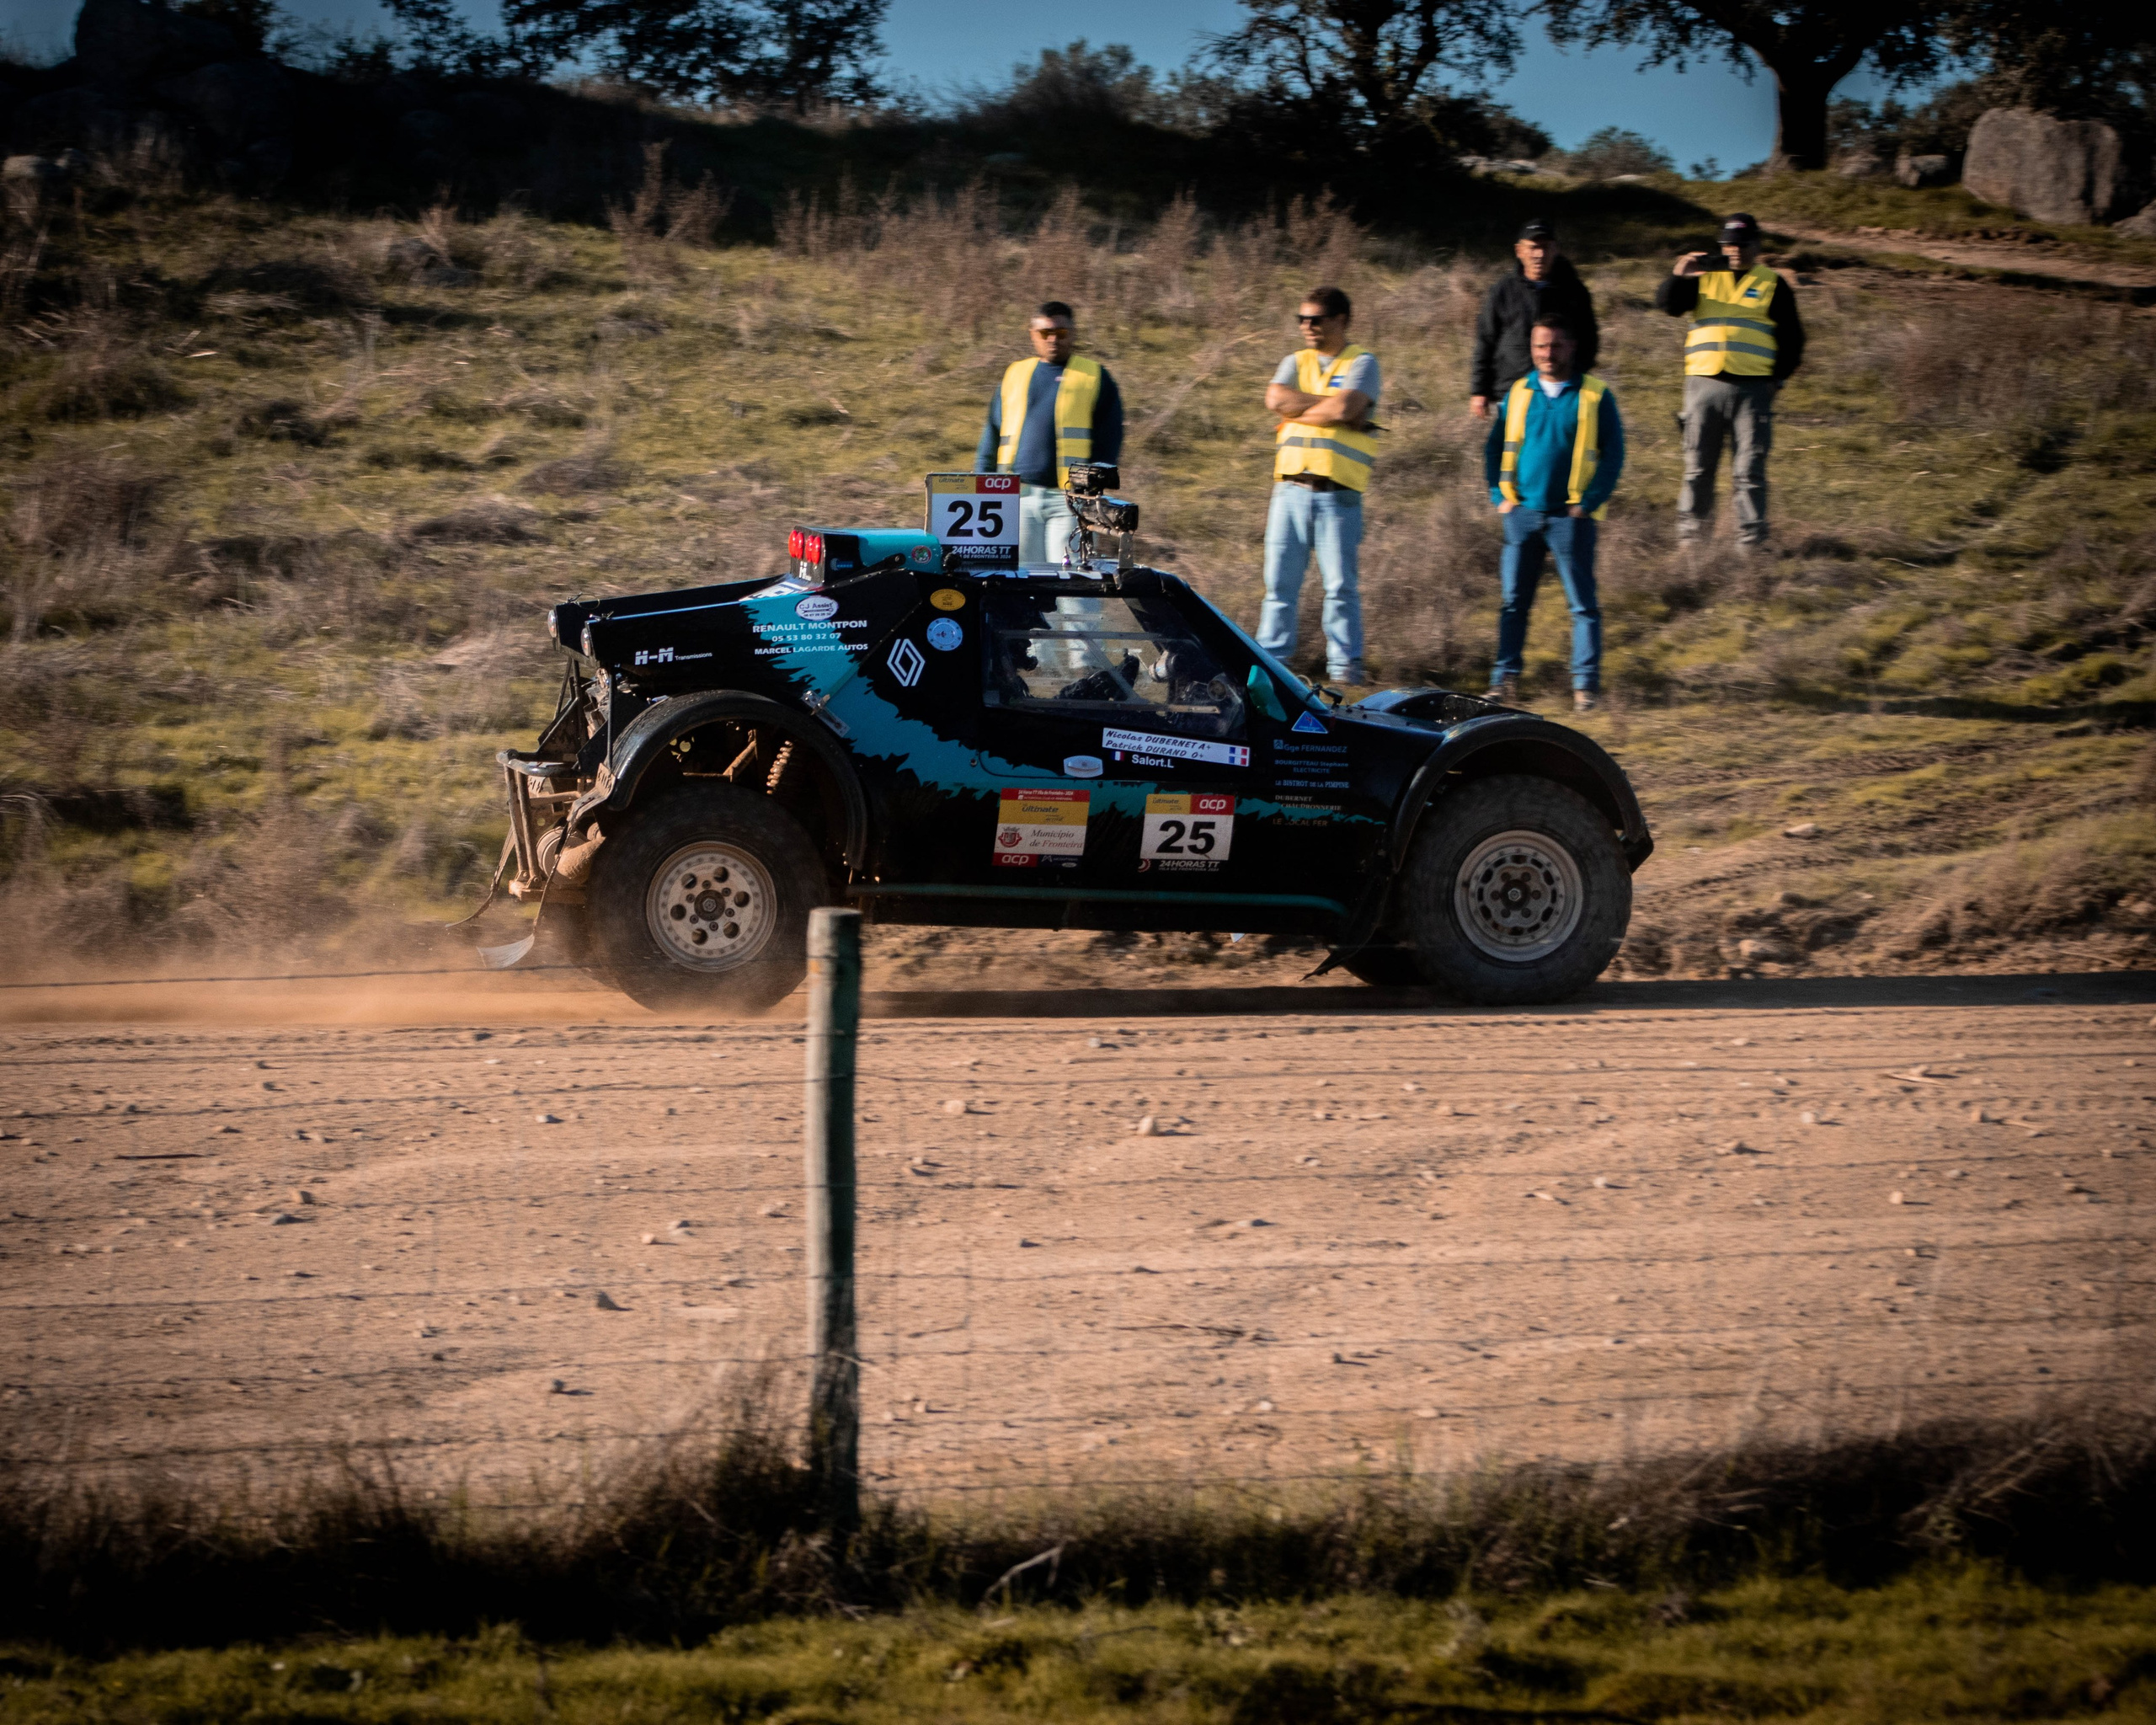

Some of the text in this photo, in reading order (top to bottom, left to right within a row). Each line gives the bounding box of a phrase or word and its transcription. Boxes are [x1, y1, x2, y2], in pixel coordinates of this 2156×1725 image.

[985, 478, 1011, 489] acp
[947, 500, 1004, 538] 25
[999, 546, 1011, 554] TT
[753, 620, 867, 633] RENAULT MONTPON
[675, 652, 712, 660] Transmissions
[1106, 730, 1142, 742] Nicolas
[1145, 735, 1196, 750] DUBERNET
[1105, 740, 1143, 751] Patrick
[1145, 745, 1187, 757] DURAND
[1283, 744, 1348, 753] Gge FERNANDEZ
[1131, 755, 1174, 768] Salort.L
[1199, 798, 1226, 811] acp
[1155, 820, 1216, 855] 25
[1042, 841, 1083, 849] Fronteira
[1001, 854, 1029, 866] acp
